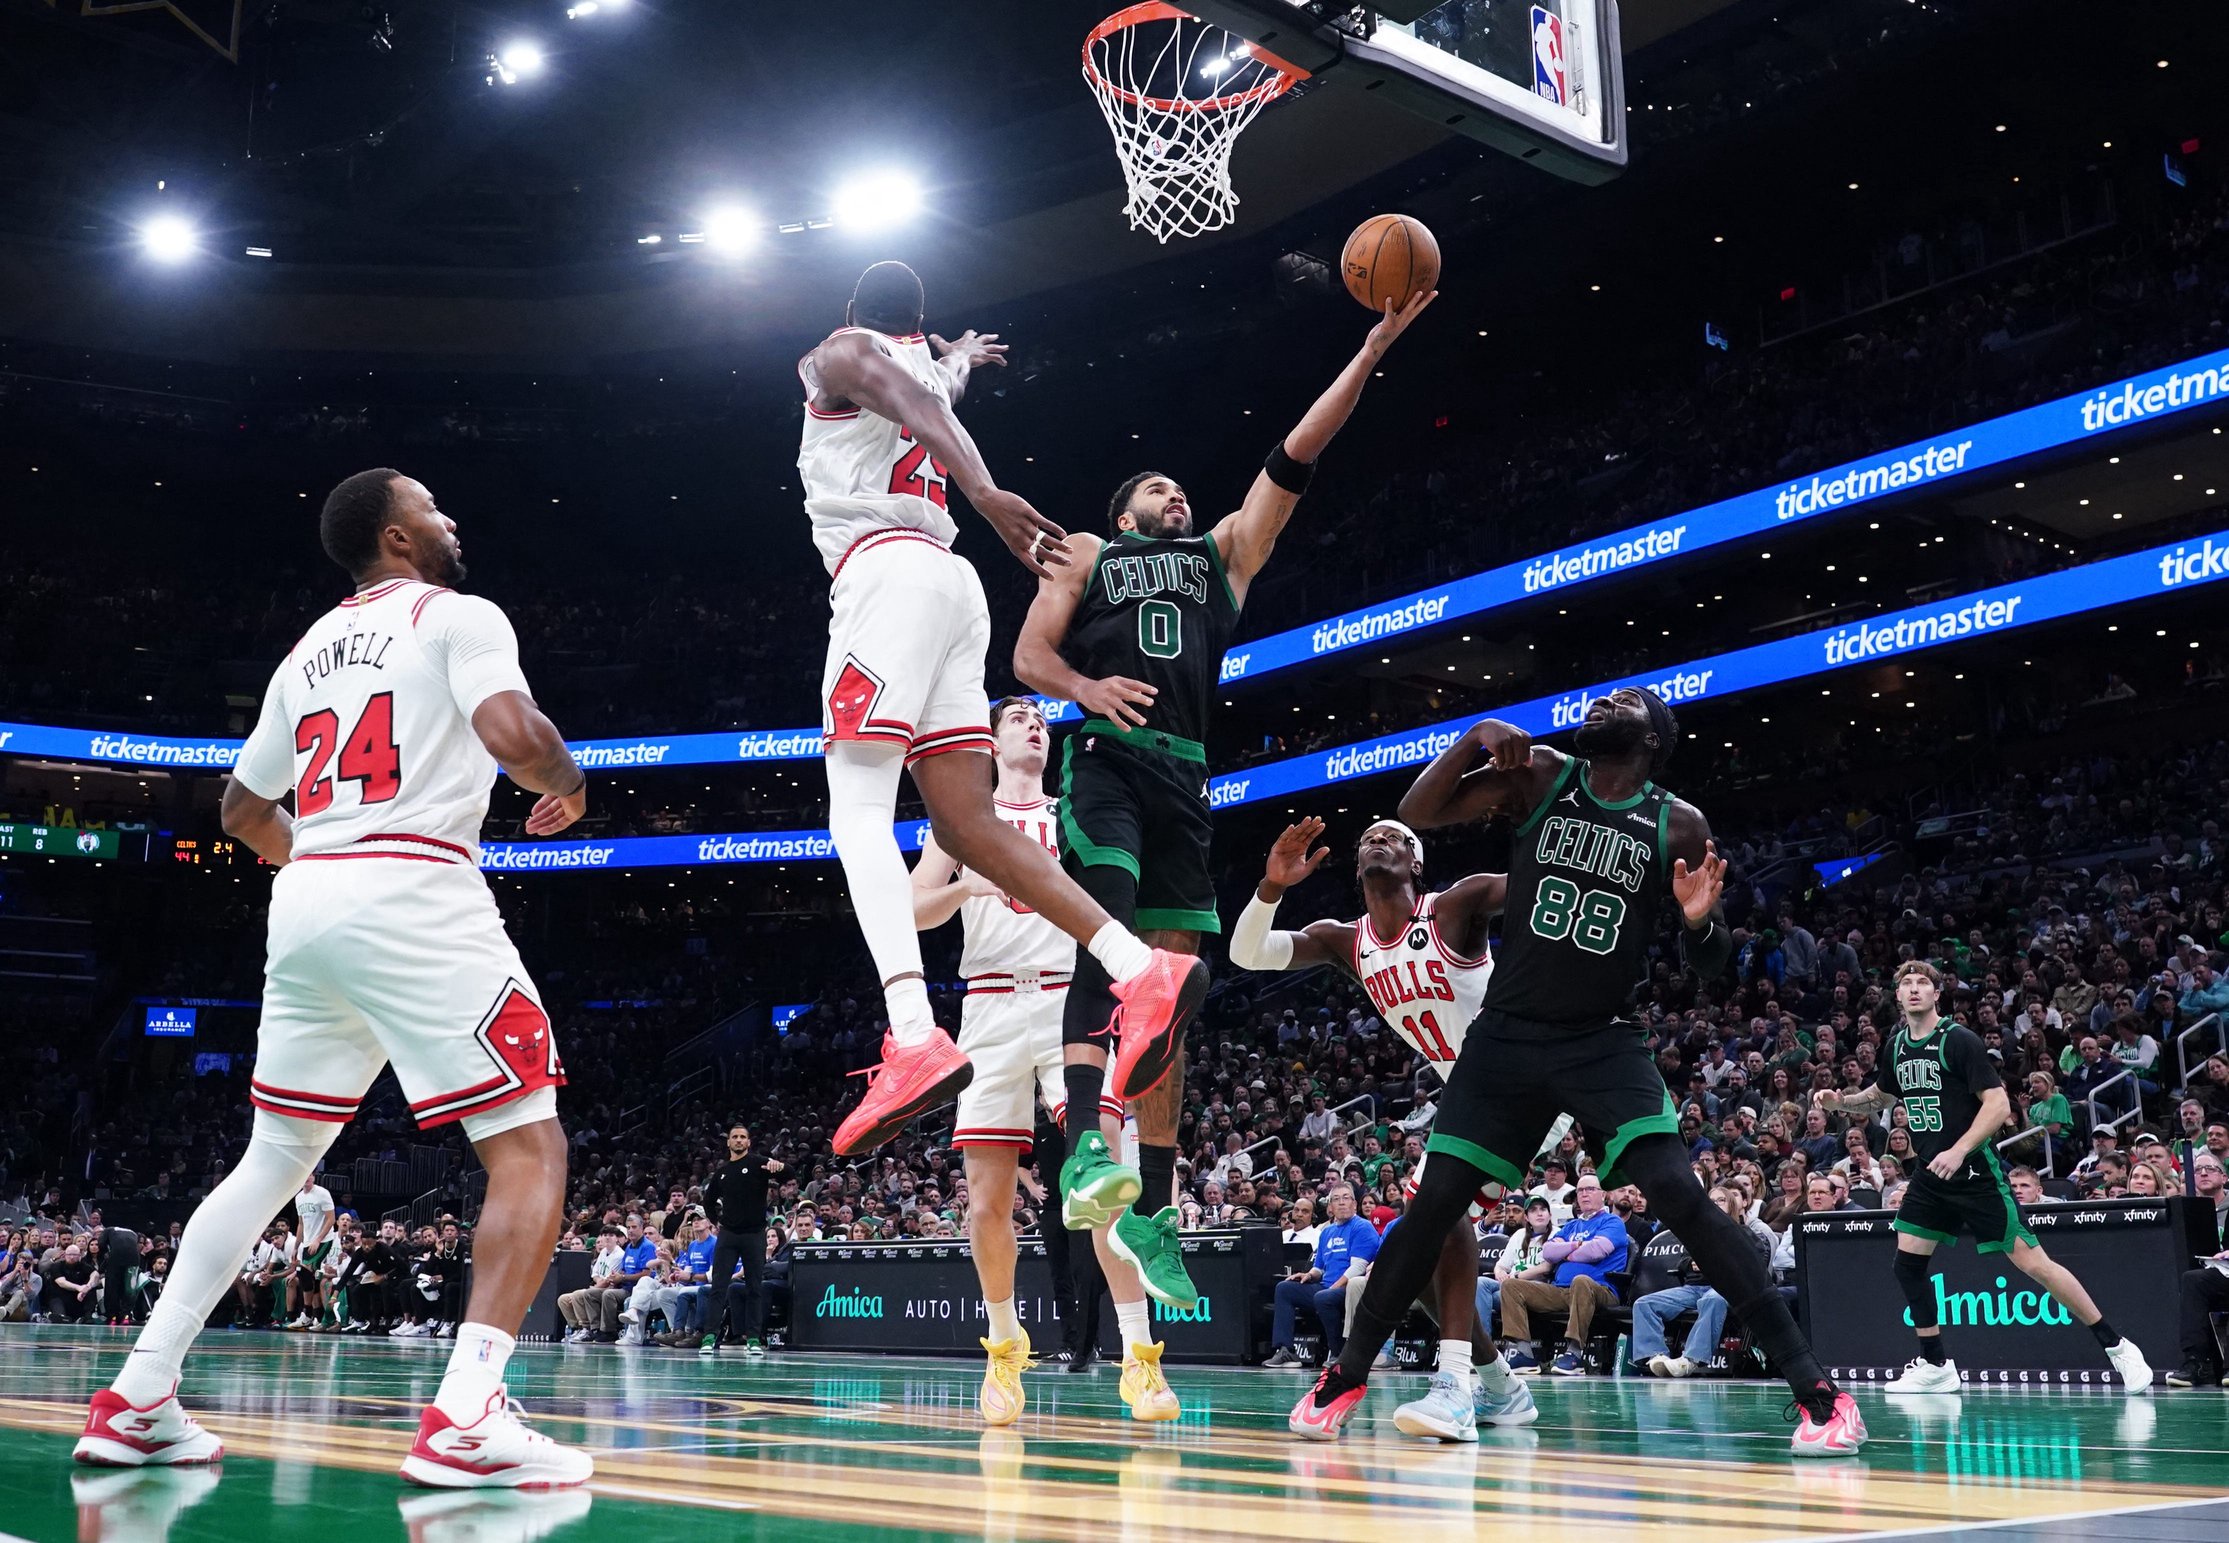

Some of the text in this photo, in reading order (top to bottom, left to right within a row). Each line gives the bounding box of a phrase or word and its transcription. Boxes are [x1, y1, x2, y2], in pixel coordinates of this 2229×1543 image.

[1540, 81, 1555, 102] NBA
[1776, 440, 1972, 520] ticketmaster
[1523, 525, 1686, 593] ticketmaster
[1100, 552, 1209, 604] CELTICS
[1138, 599, 1182, 659] 0
[1312, 596, 1449, 653] ticketmaster
[1824, 596, 2022, 665] ticketmaster
[303, 632, 393, 690] POWELL
[91, 735, 241, 765] ticketmaster
[294, 690, 401, 819] 24
[569, 742, 670, 767] etmaster
[738, 733, 824, 758] ticketm
[1326, 729, 1461, 780] ticketmaster
[0, 825, 48, 836] AST REB
[1627, 811, 1657, 829] Amica
[1, 836, 44, 850] 11 8
[175, 852, 191, 862] 44
[213, 842, 233, 854] 2.4
[479, 845, 614, 868] ticketmaster
[698, 836, 836, 861] ticketmaster
[1535, 816, 1651, 893] CELTICS
[1529, 875, 1627, 955] 88
[1363, 960, 1456, 1016] BULLS
[1402, 1010, 1456, 1062] 11
[1896, 1058, 1943, 1092] CELTICS
[1903, 1096, 1944, 1132] 55
[1802, 1221, 1831, 1234] xfinity
[1845, 1220, 1874, 1233] xfinity
[2074, 1211, 2107, 1224] xfinity
[2124, 1208, 2158, 1222] xfinity
[816, 1283, 884, 1319] Amica
[905, 1300, 1027, 1320] AUTO HE
